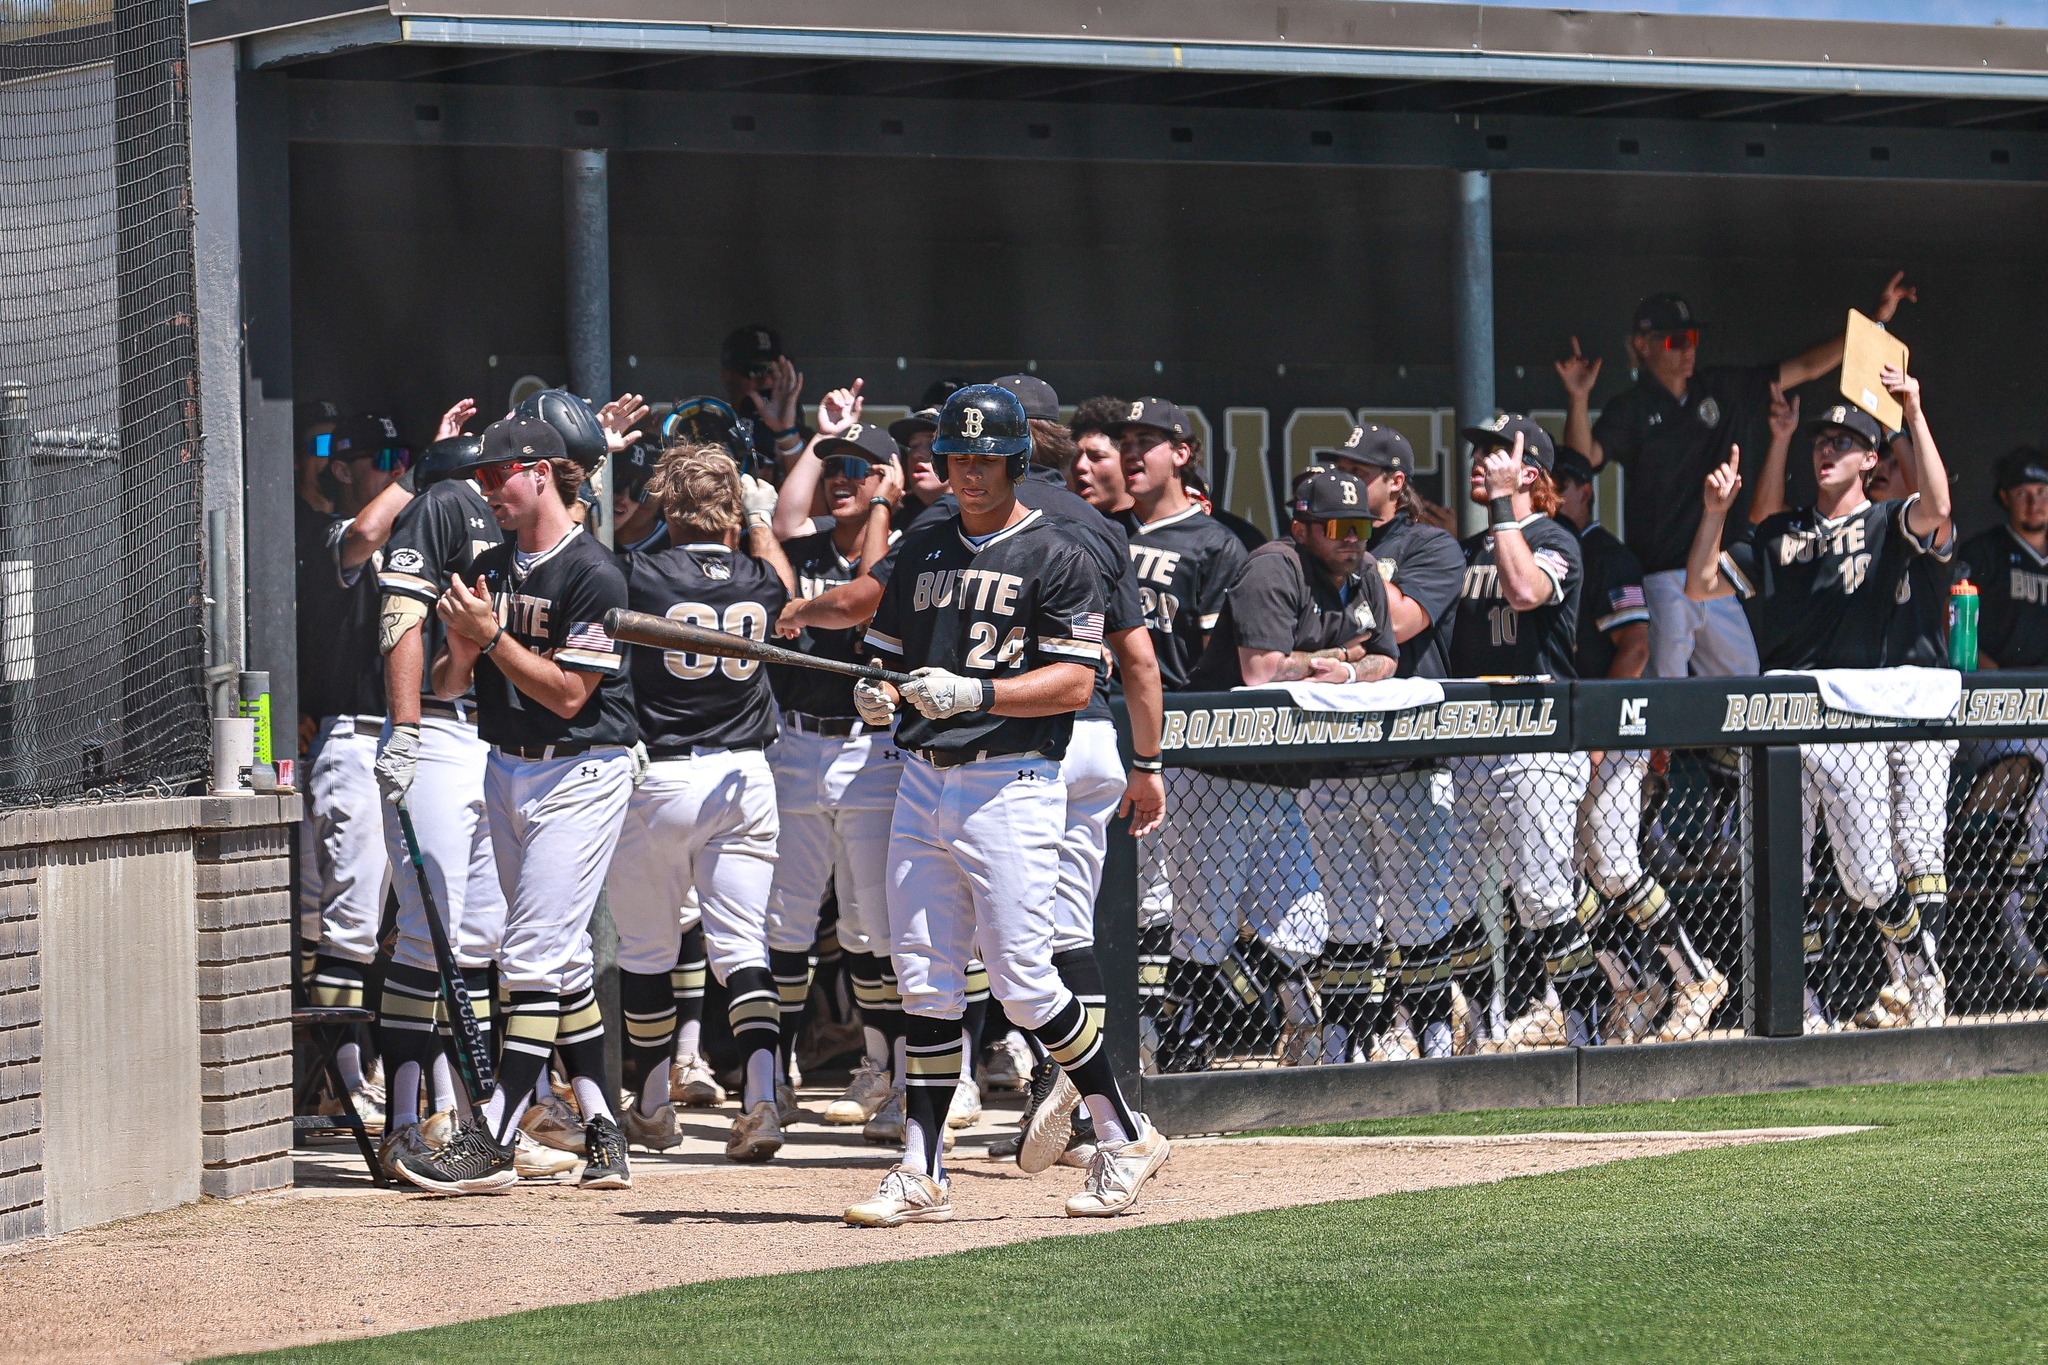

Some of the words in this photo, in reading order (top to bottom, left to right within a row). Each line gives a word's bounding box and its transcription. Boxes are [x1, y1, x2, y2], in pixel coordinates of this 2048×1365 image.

[960, 407, 985, 439] B
[1127, 401, 1145, 421] B
[379, 418, 398, 438] B
[841, 423, 863, 442] B
[1344, 426, 1364, 449] B
[631, 444, 646, 466] B
[1340, 480, 1359, 505] B
[913, 569, 1024, 617] BUTTE
[2010, 567, 2048, 607] BUT
[1488, 605, 1518, 647] 10
[965, 621, 1027, 670] 24
[1160, 706, 1384, 750] ROADRUNNER
[1387, 698, 1558, 742] BASEBALL
[1620, 697, 1649, 726] NC
[450, 977, 496, 1091] LOUISVILLE
